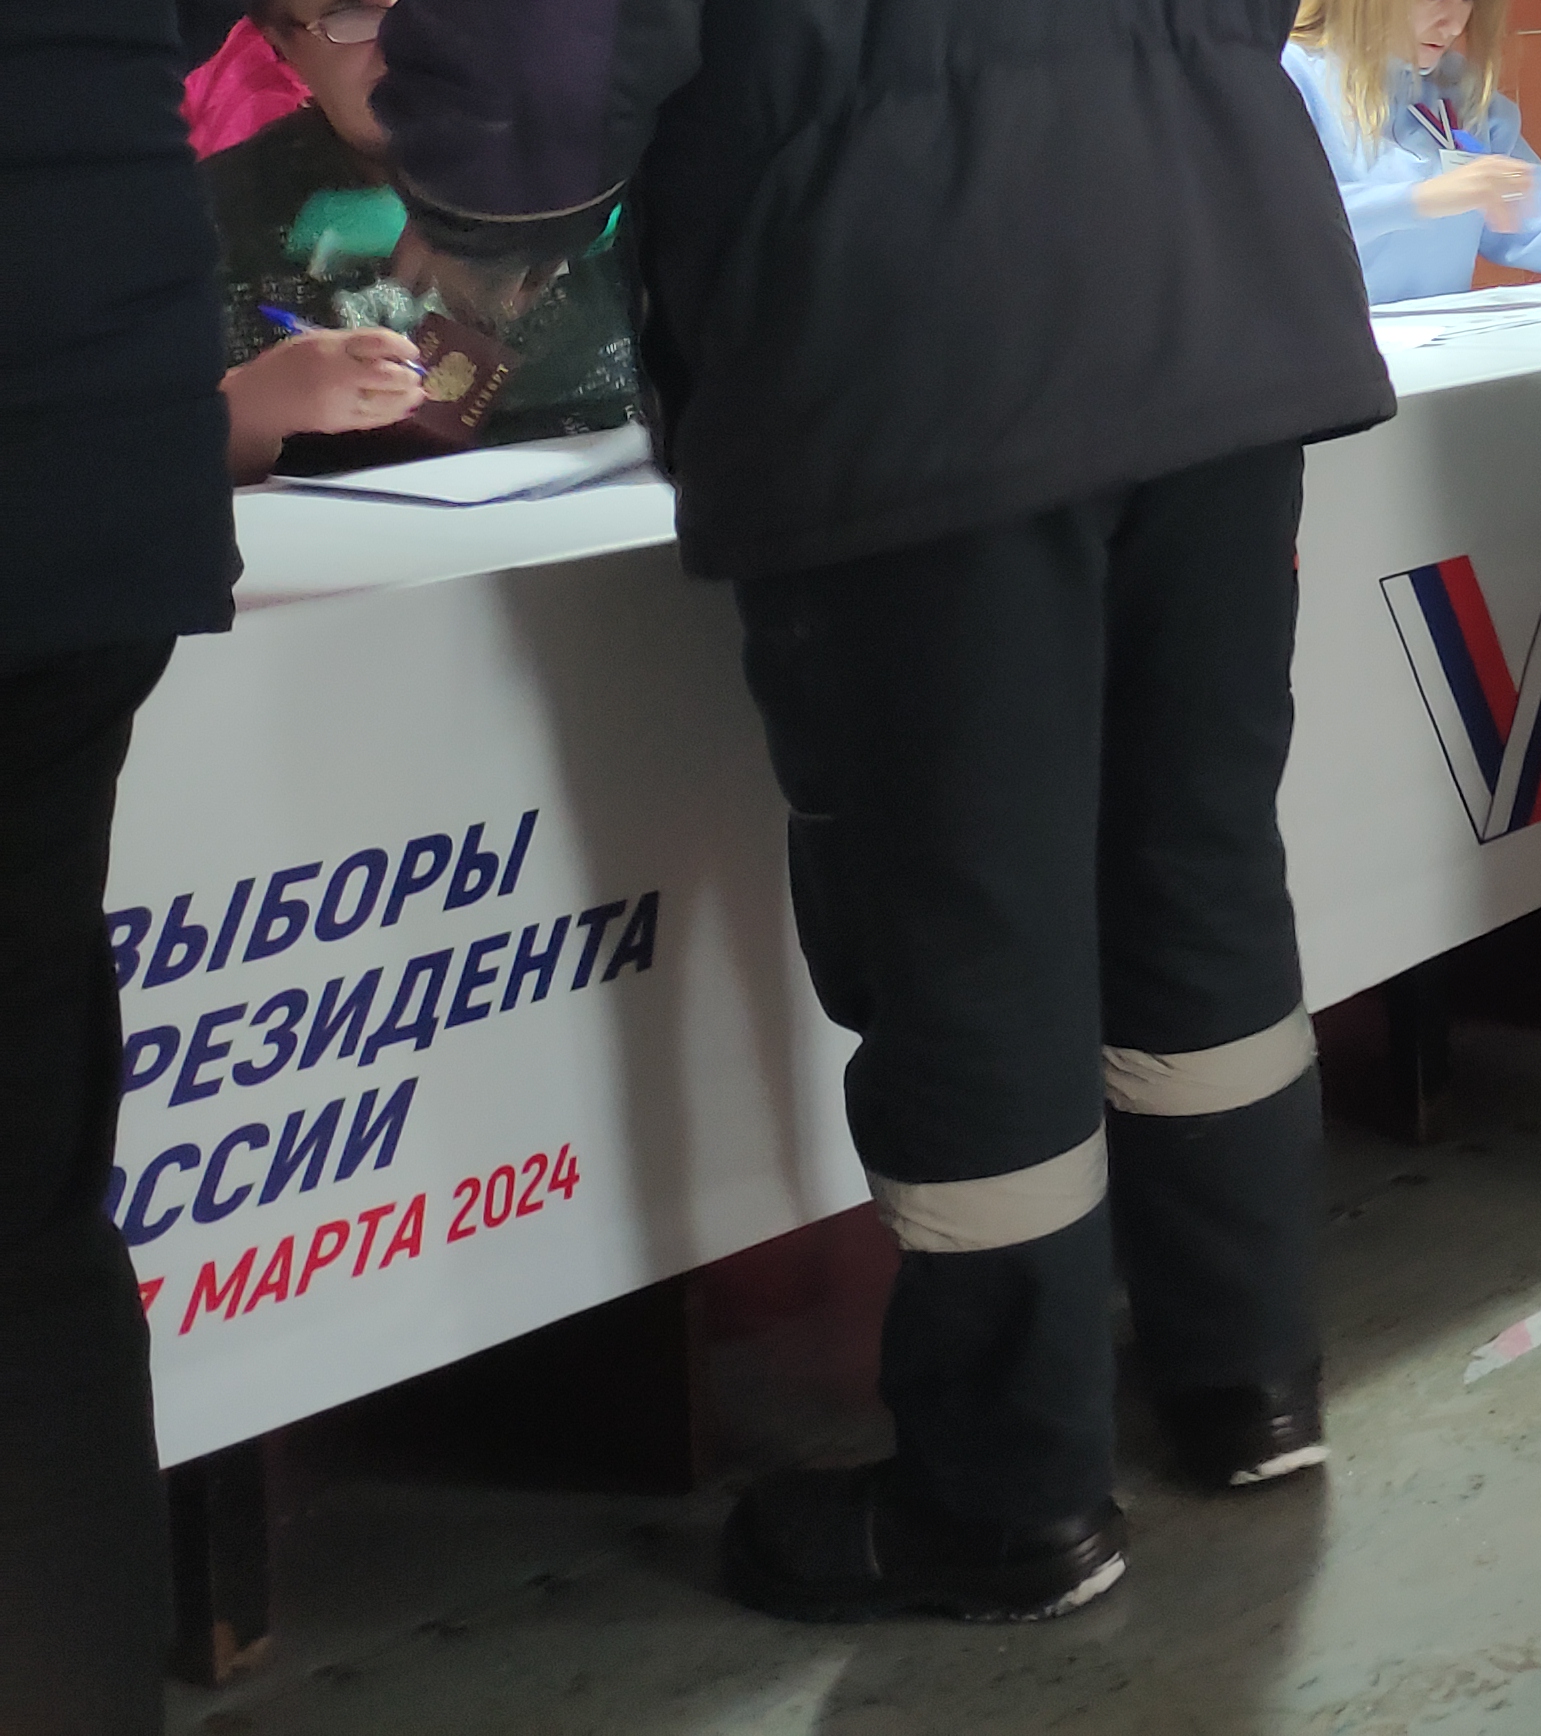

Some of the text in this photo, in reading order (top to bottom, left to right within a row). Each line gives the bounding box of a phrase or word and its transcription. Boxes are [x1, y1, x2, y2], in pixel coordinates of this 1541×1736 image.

[104, 808, 540, 993] ВЫБОРЫ
[121, 890, 661, 1109] РЕЗИДЕНТА
[104, 1077, 420, 1247] ССИИ
[177, 1142, 582, 1337] МАРТА 2024
